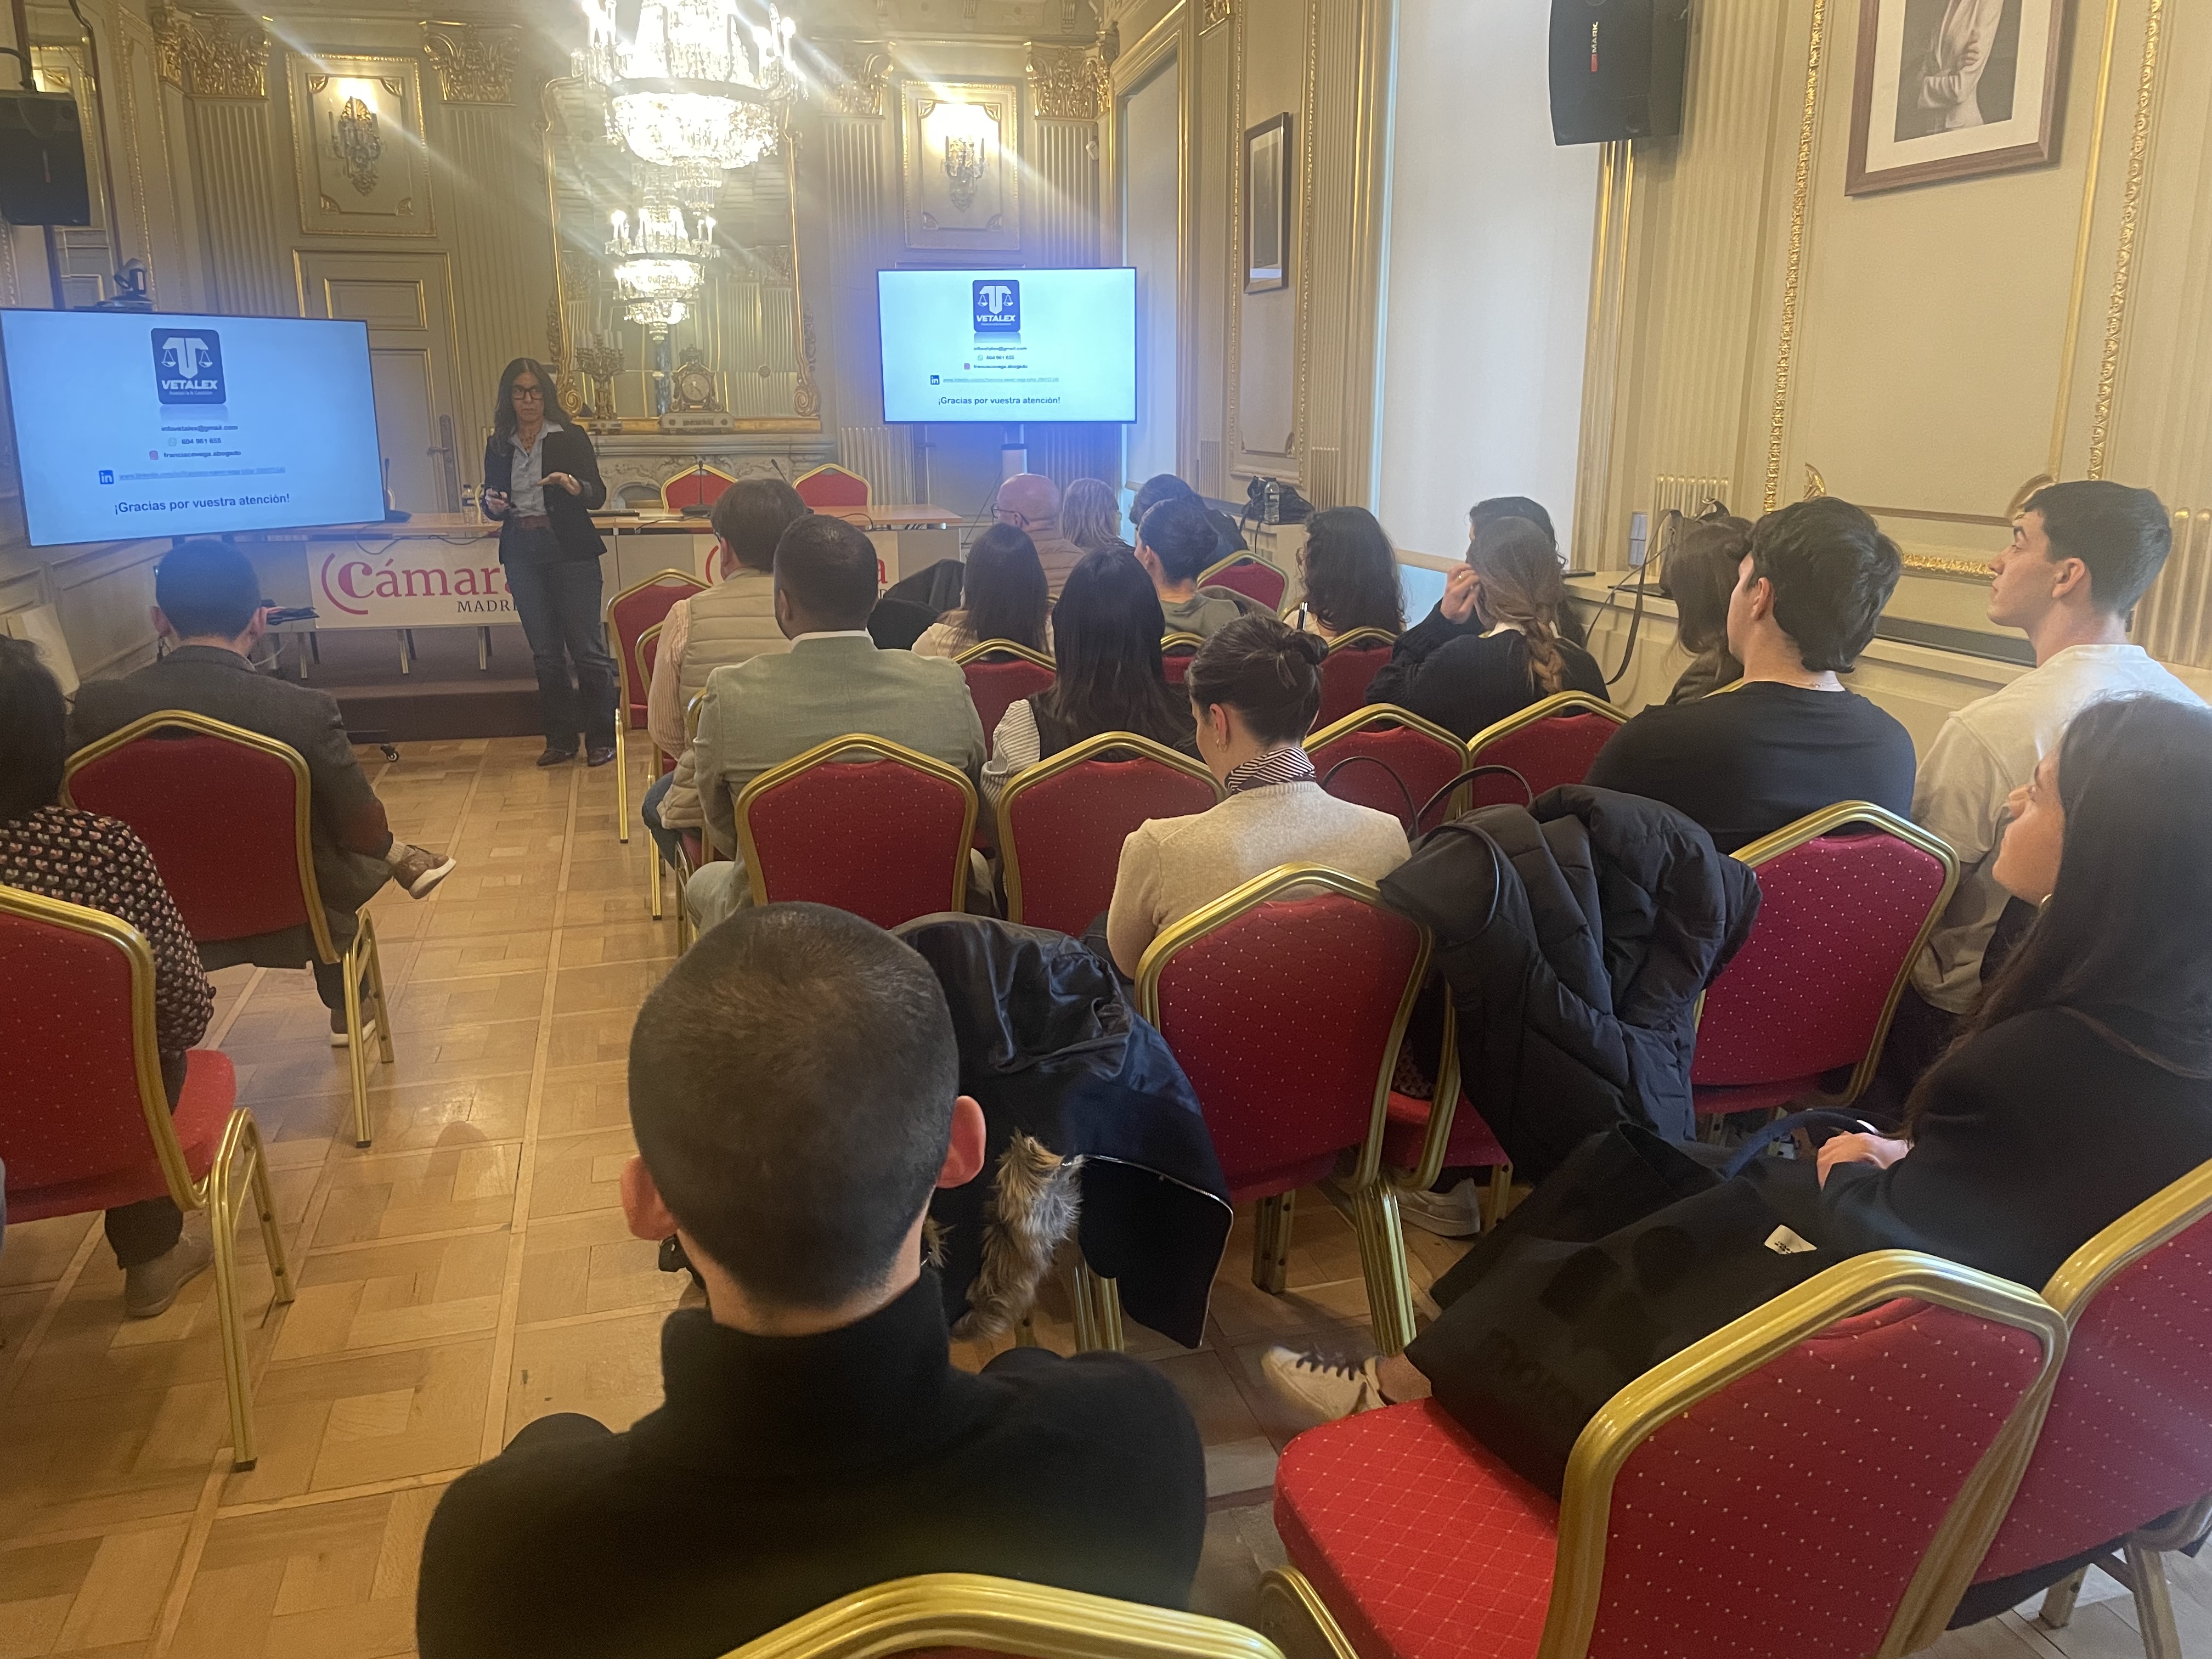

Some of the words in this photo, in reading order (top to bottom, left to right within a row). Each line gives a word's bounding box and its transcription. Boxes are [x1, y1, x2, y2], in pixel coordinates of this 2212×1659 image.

[161, 380, 218, 390] VETALEX
[938, 397, 972, 405] ¡Gracias
[114, 500, 166, 515] ¡Gracias
[170, 501, 190, 512] por
[192, 496, 236, 508] vuestra
[239, 493, 290, 506] atención!
[337, 558, 512, 599] Cámar
